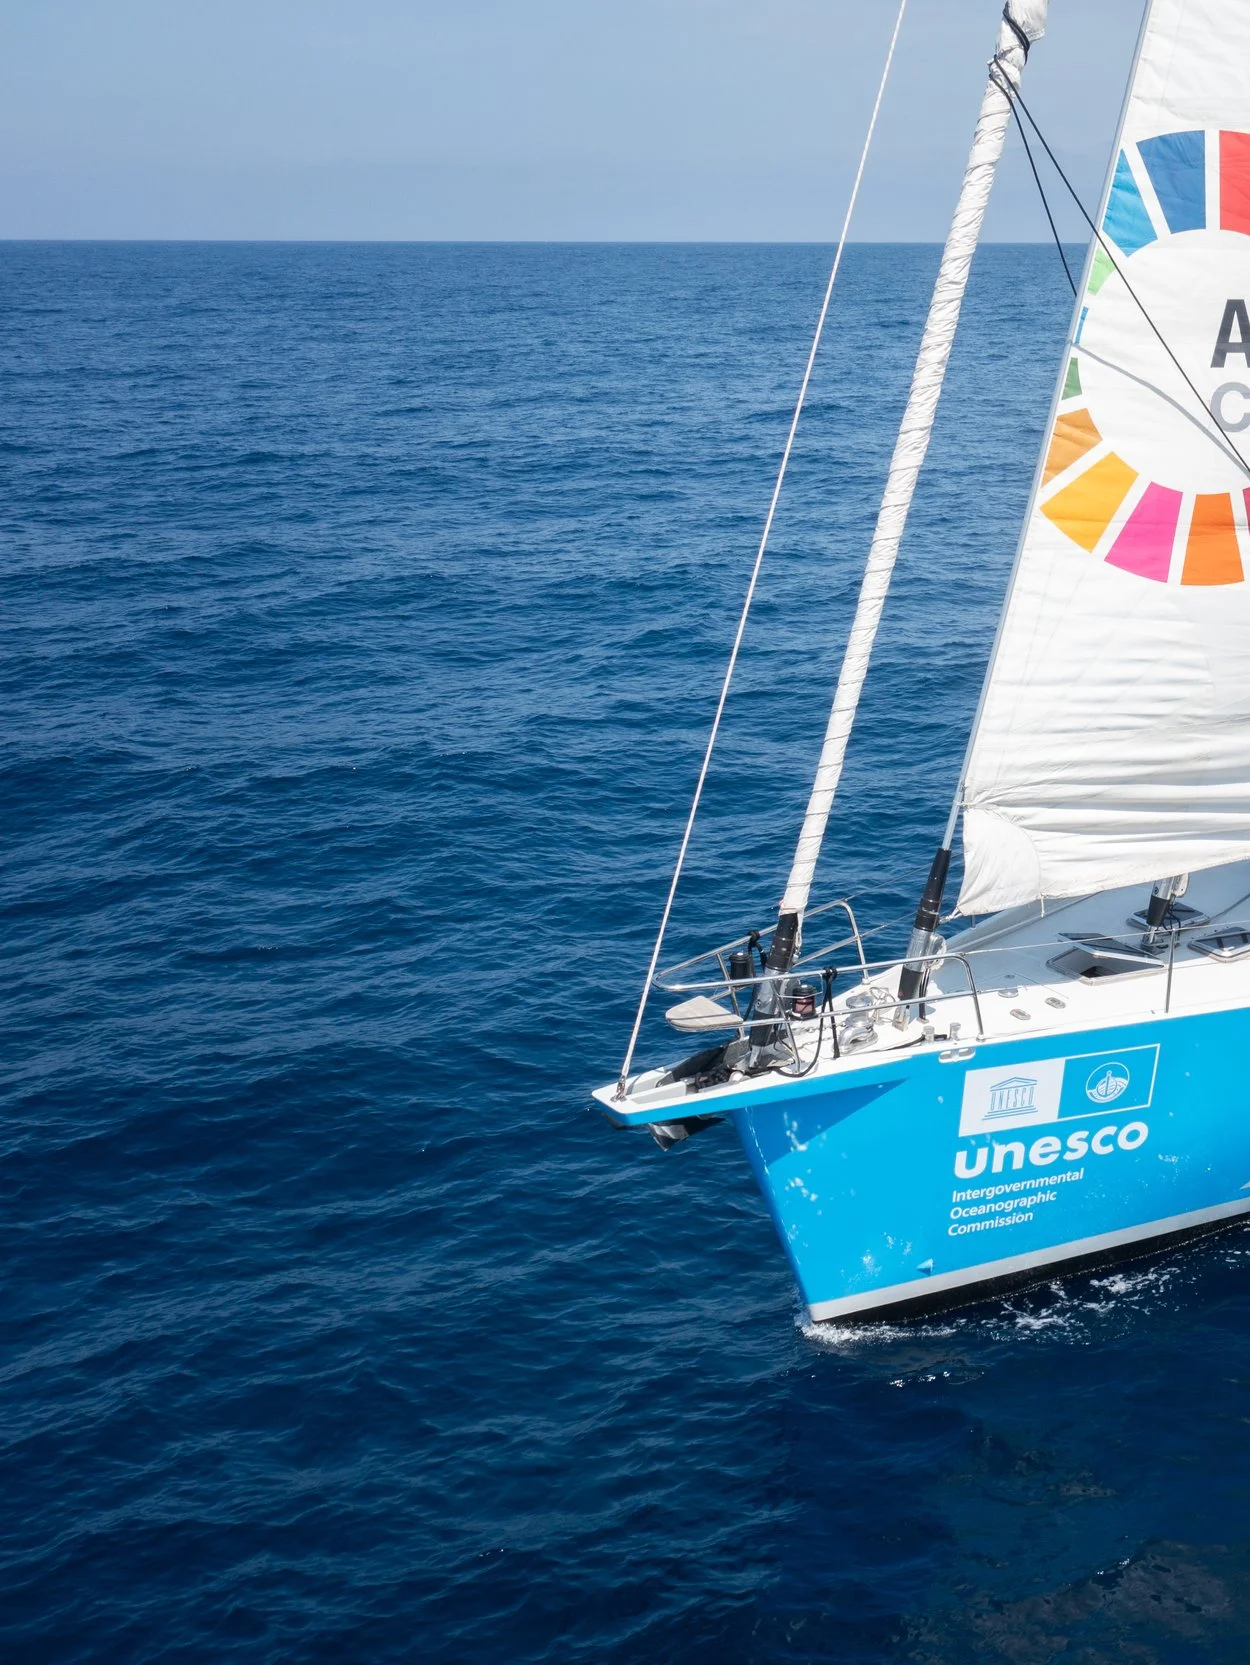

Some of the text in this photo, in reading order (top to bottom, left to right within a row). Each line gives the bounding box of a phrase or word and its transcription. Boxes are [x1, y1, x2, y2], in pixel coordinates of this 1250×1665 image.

[991, 1086, 1034, 1111] UNESCO
[954, 1121, 1149, 1179] unesco
[952, 1168, 1084, 1203] Intergovernmental
[950, 1190, 1057, 1220] Oceanographic
[947, 1211, 1034, 1237] Commission
